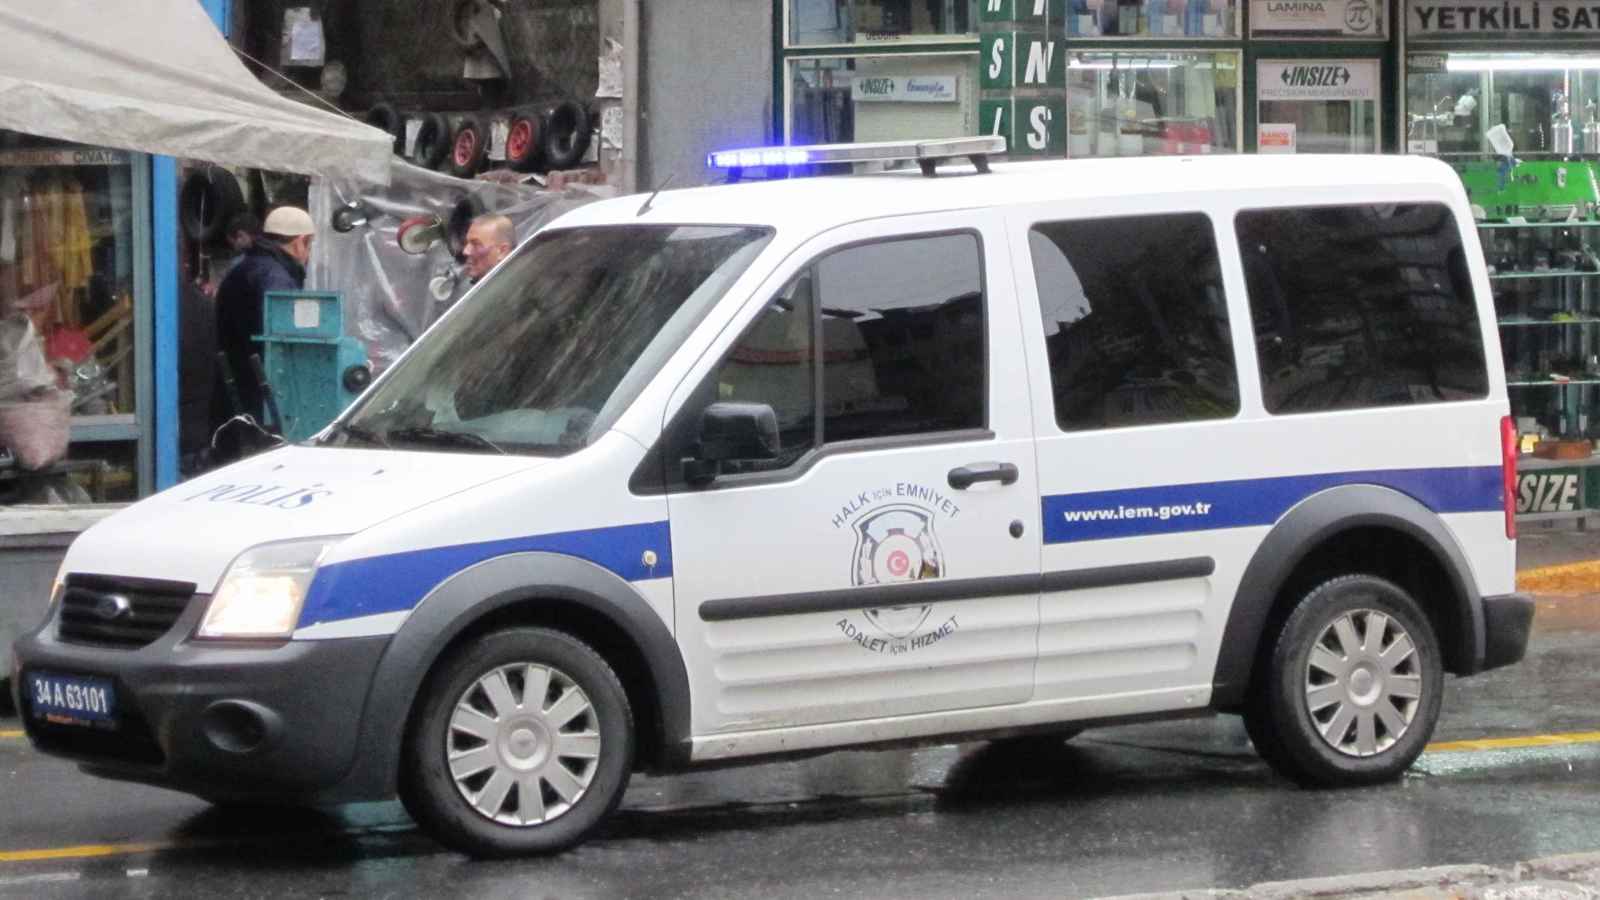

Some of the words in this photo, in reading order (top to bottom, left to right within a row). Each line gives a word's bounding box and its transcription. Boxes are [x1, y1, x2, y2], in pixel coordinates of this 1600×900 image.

[1415, 2, 1540, 29] YETKİLİ
[1289, 66, 1342, 86] INSIZE
[832, 491, 871, 528] HALK
[896, 483, 960, 518] EMNİYET
[1516, 474, 1578, 512] SIZE
[1063, 502, 1212, 522] www.iem.gov.tr
[836, 618, 888, 653] ADALET
[35, 679, 51, 706] 34
[54, 682, 66, 708] A
[65, 684, 107, 713] 63101
